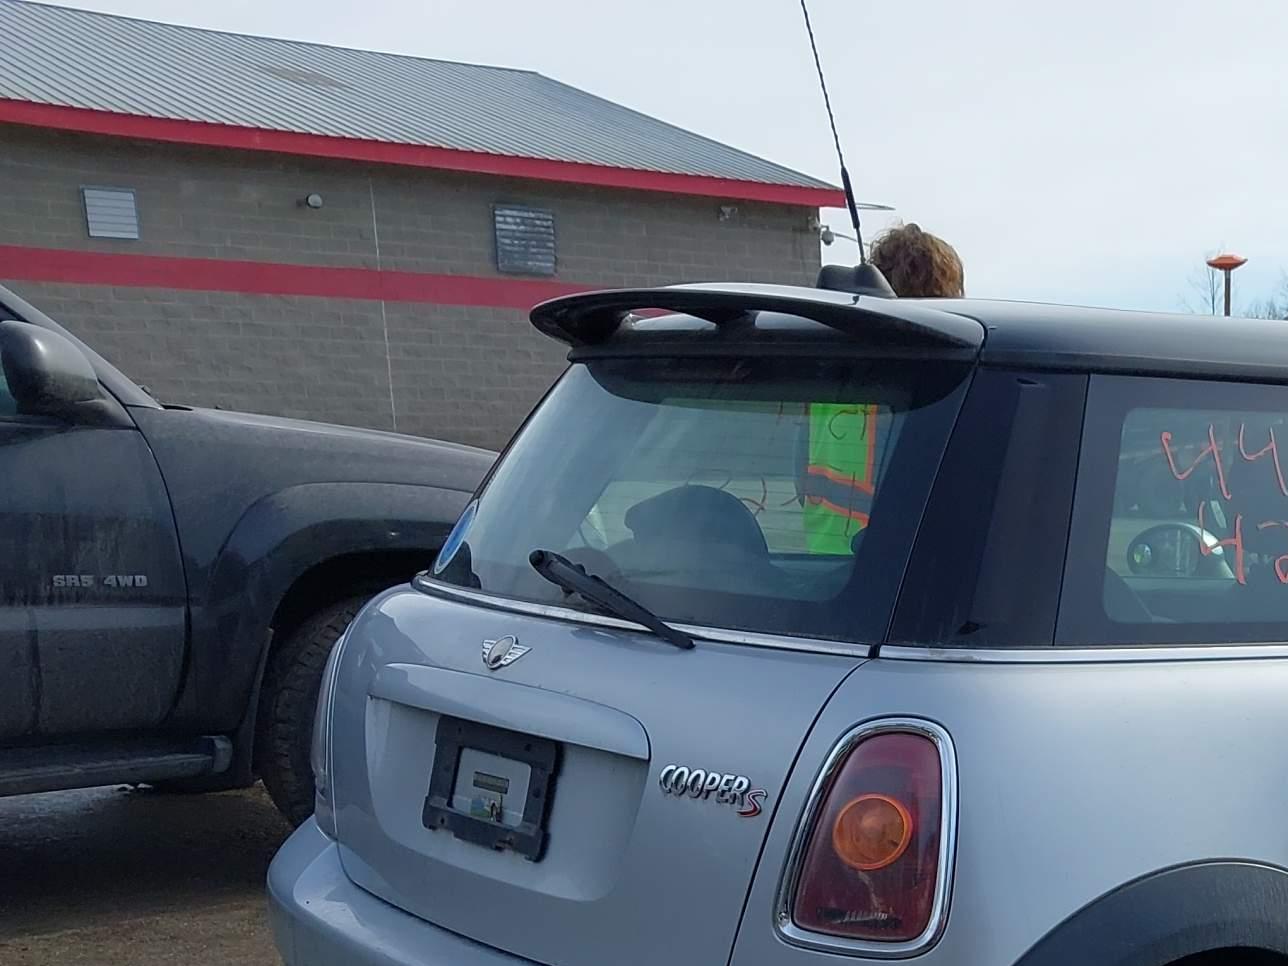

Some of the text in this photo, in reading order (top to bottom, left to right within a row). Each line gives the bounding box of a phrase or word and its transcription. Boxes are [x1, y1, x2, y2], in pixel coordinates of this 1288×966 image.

[53, 574, 148, 587] SR5 4WD
[660, 765, 768, 817] COOPER S
